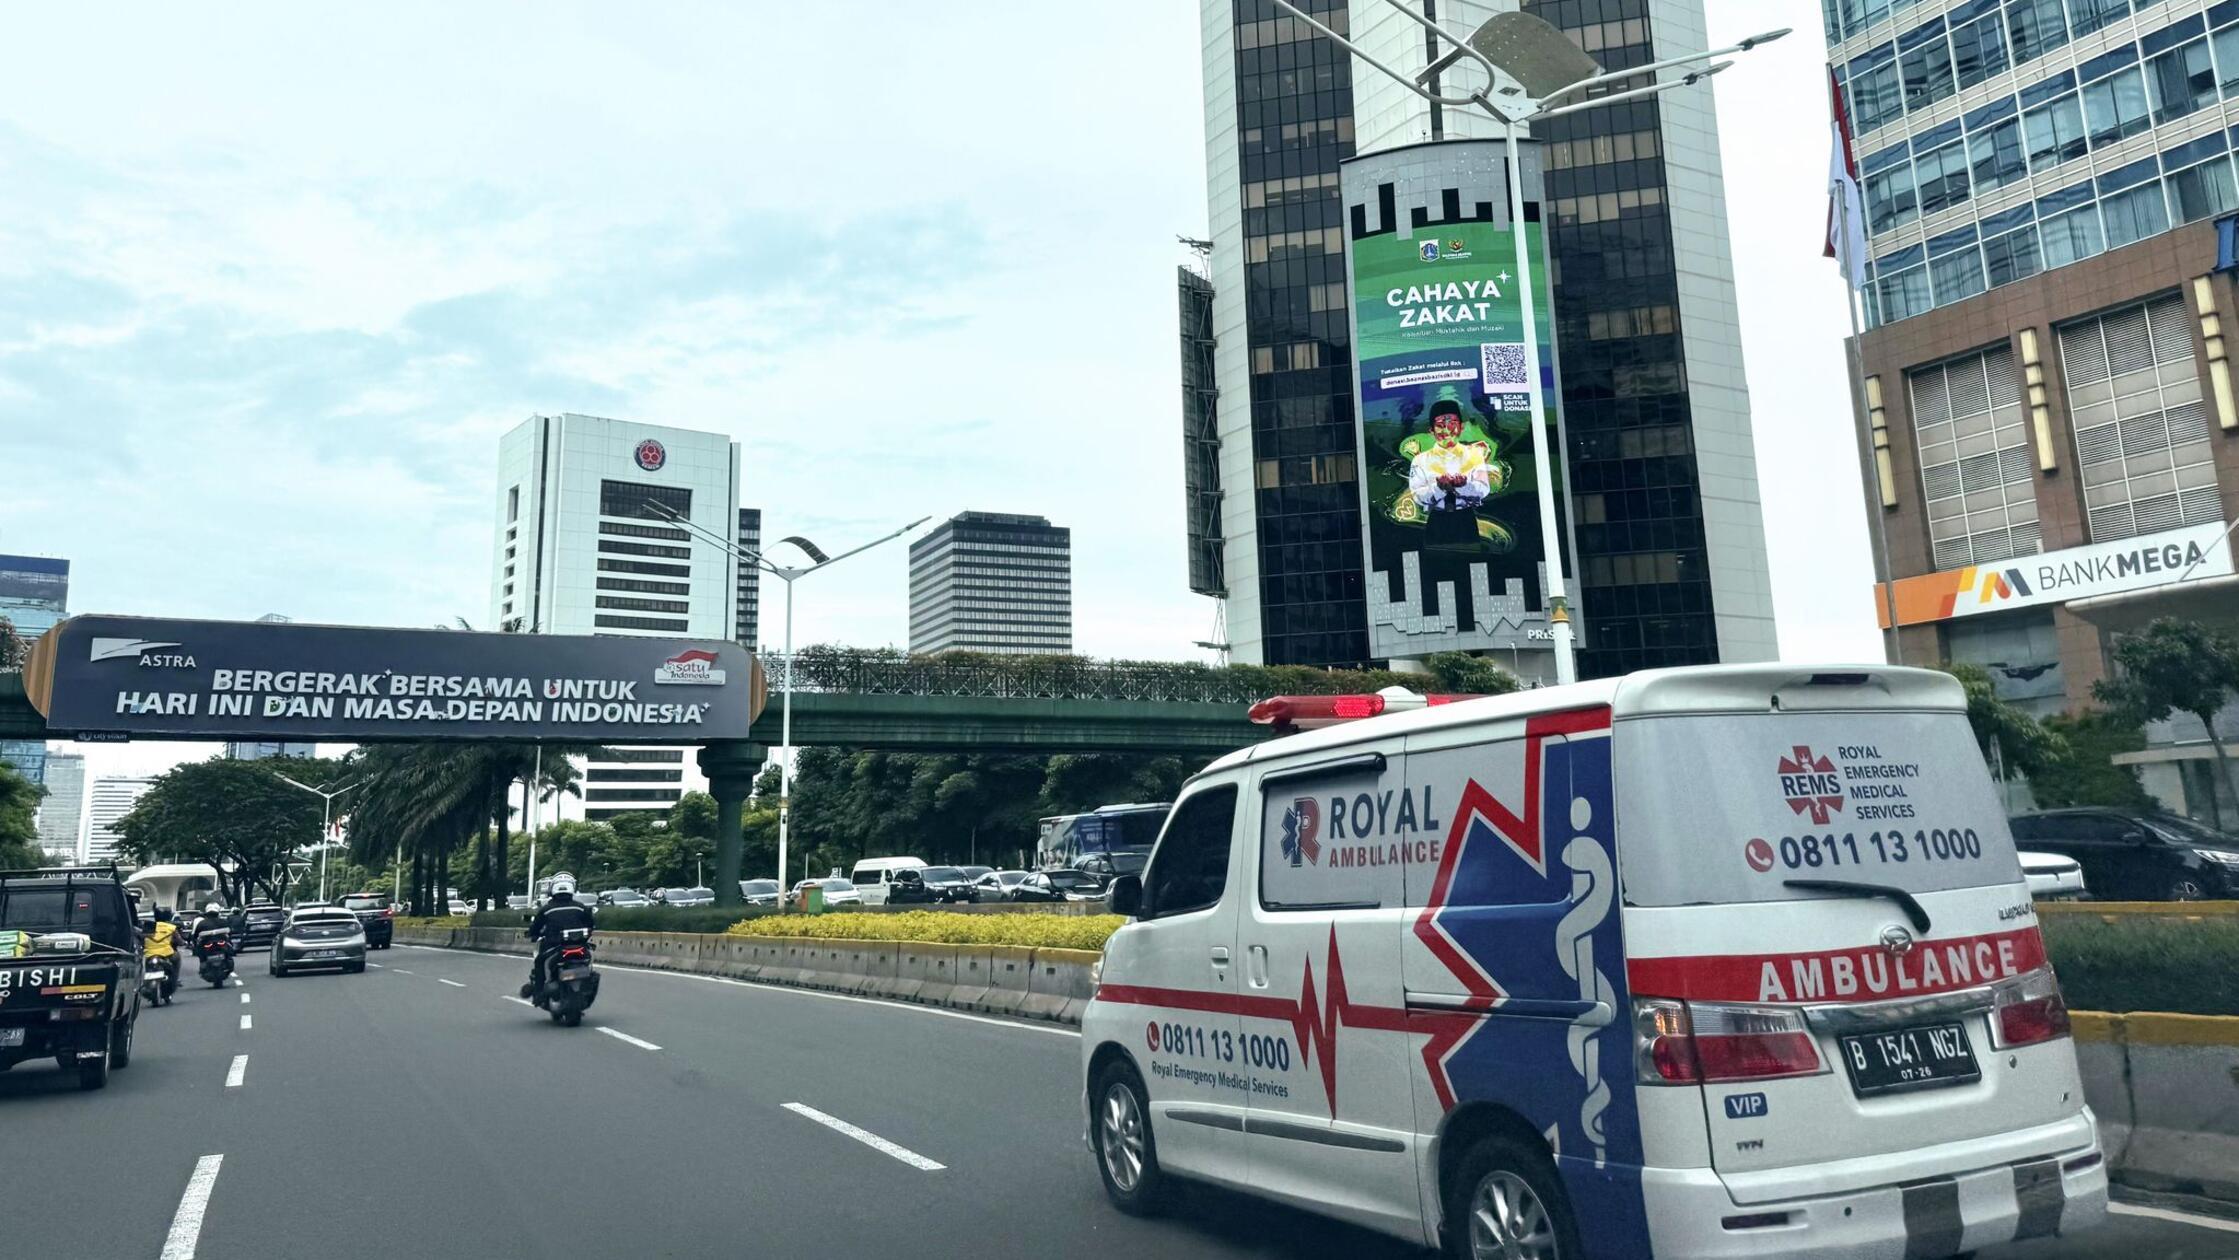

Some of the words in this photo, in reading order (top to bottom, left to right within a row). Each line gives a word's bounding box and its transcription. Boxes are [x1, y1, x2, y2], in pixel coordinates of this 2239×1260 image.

[1387, 280, 1501, 306] CAHAYA
[1399, 303, 1491, 328] ZAKAT
[139, 654, 197, 668] ASTRA
[212, 669, 380, 696] BERGERAK
[389, 674, 534, 700] BERSAMA
[543, 678, 638, 701] UNTUK
[671, 671, 710, 680] Indonesia
[116, 691, 198, 716] HARI
[208, 694, 252, 717] INI
[263, 696, 333, 719] DAN
[343, 698, 435, 721] MASA
[446, 700, 543, 723] DEPAN
[551, 702, 703, 725] INDONESIA
[1838, 745, 1882, 760] ROYAL
[1844, 764, 1920, 780] EMERGENCY
[1780, 774, 1841, 797] REMS
[1850, 784, 1908, 800] MEDICAL
[1329, 784, 1440, 840] ROYAL
[1856, 803, 1916, 821] SERVICES
[1328, 840, 1440, 868] AMBULANCE
[1780, 832, 1861, 870] 0811
[1869, 830, 1909, 864] 13
[1914, 827, 1982, 861] 1000
[1759, 939, 2019, 1002] AMBULANCE
[1163, 1022, 1205, 1058] 0811
[1211, 1029, 1234, 1063] 13
[1238, 1033, 1290, 1072] 1000
[1850, 1040, 1867, 1071] B
[1876, 1032, 1922, 1067] 1541
[1929, 1027, 1969, 1060] NGZ
[1152, 1060, 1173, 1077] Royal
[1174, 1064, 1217, 1089] Emergency
[1218, 1071, 1251, 1092] Medical
[1252, 1077, 1289, 1098] Services
[1730, 1095, 1763, 1115] VIP
